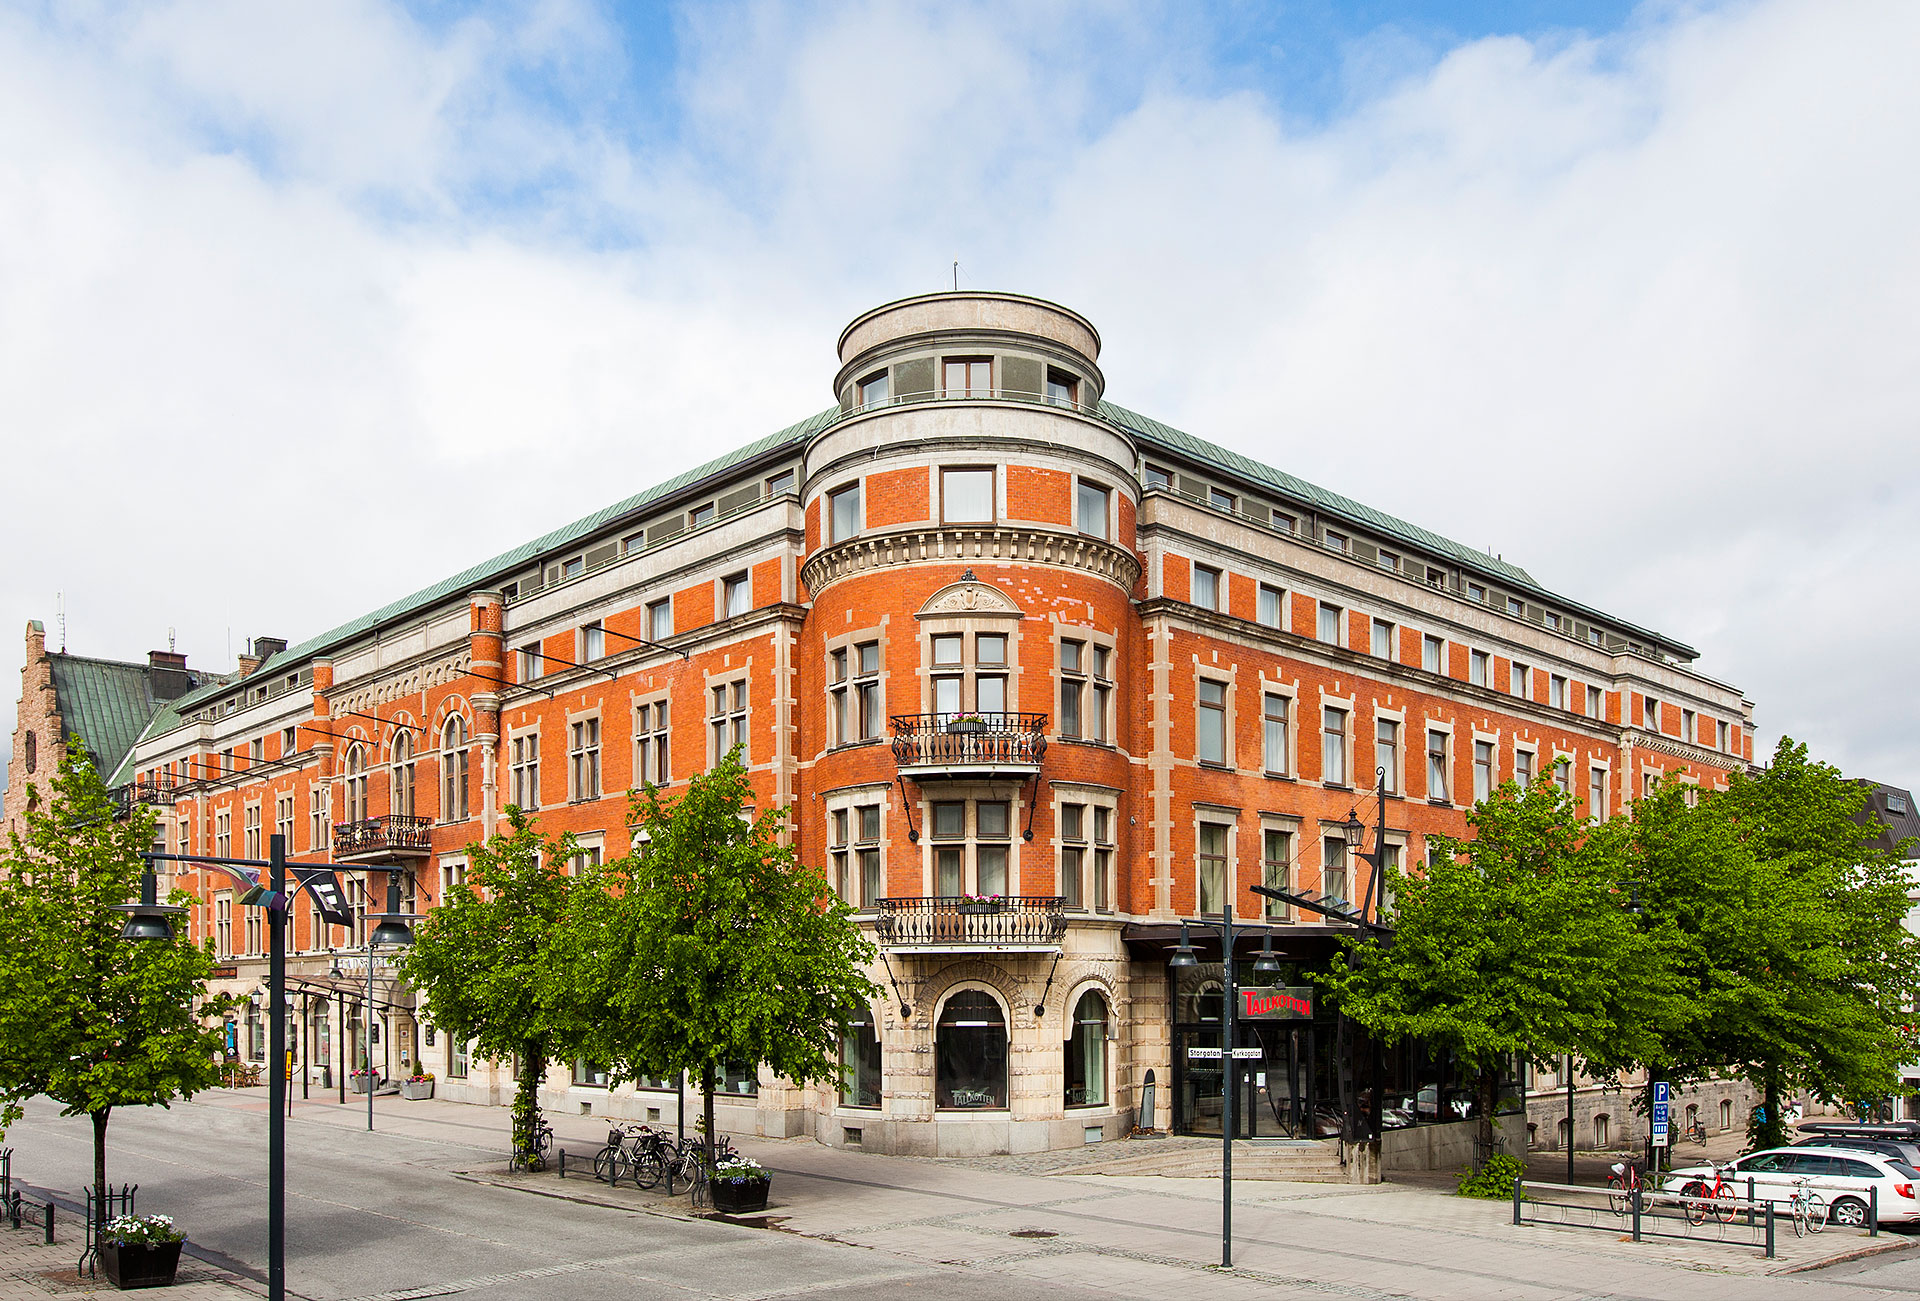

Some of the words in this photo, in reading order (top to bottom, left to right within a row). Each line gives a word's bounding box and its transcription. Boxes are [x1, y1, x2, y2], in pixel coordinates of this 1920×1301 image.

[1242, 991, 1310, 1016] TALLKOTTEN
[951, 1090, 995, 1106] TALLKOTTEN
[1658, 1085, 1666, 1101] P
